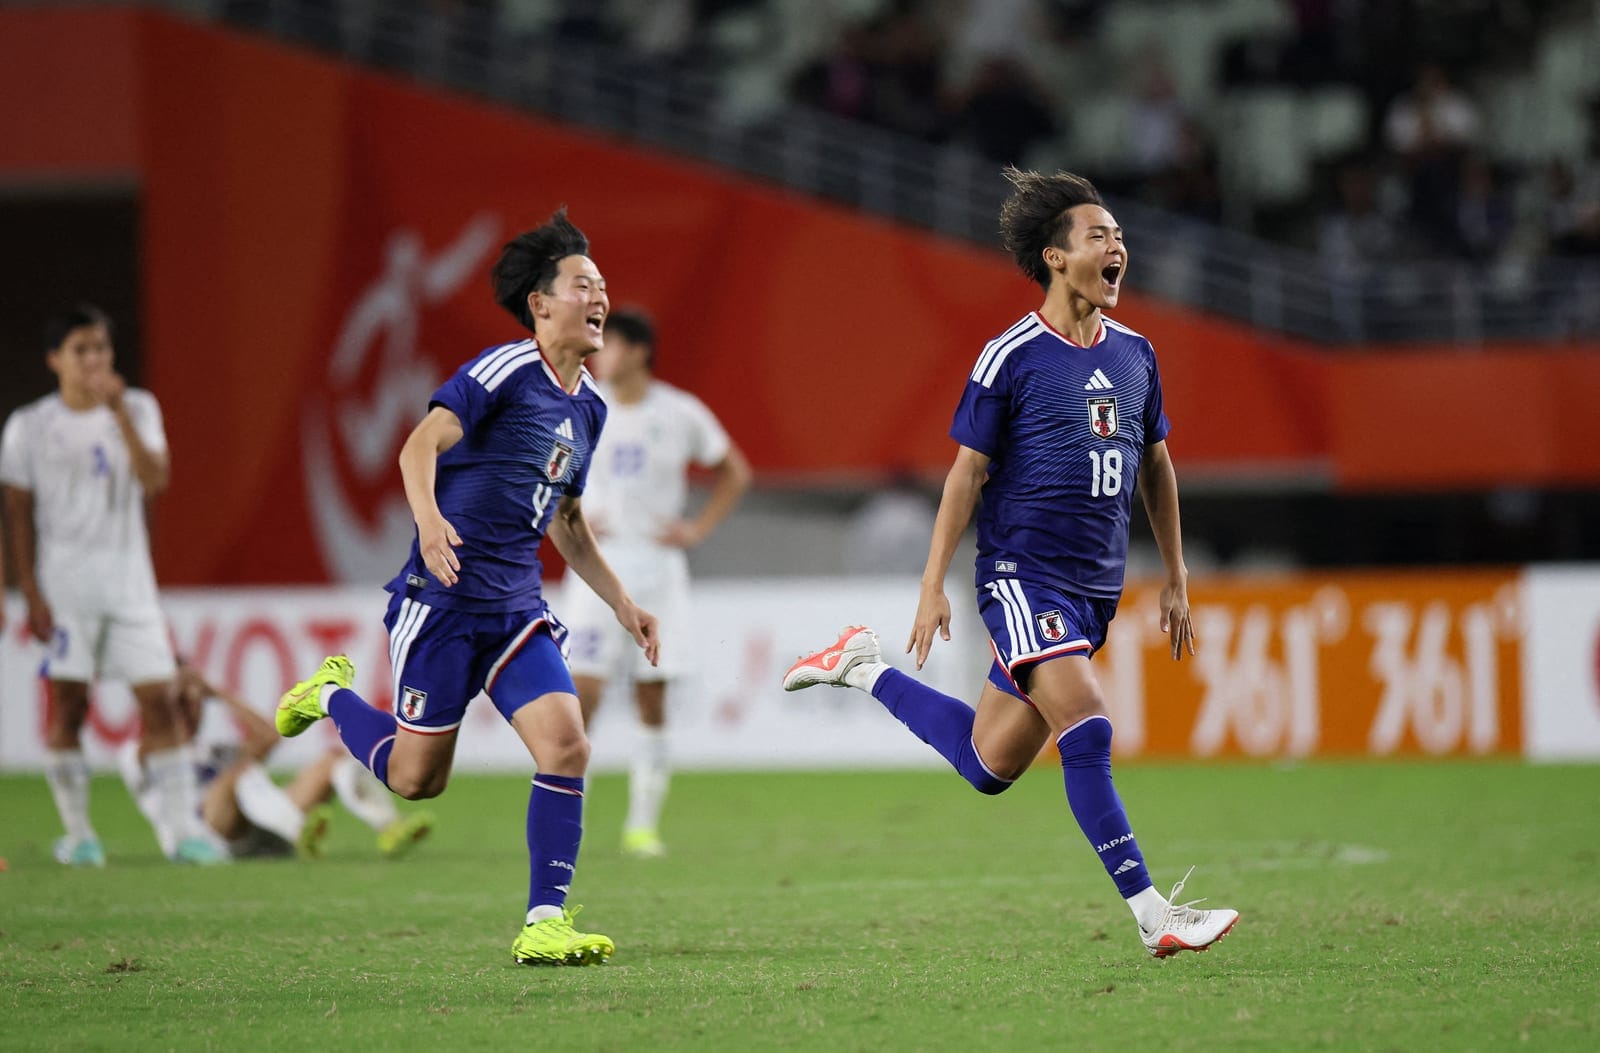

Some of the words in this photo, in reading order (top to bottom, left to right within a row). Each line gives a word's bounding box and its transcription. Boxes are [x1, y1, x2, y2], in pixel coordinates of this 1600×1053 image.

[1089, 449, 1122, 497] 18
[531, 483, 552, 529] 4
[1097, 832, 1134, 853] JAPAN
